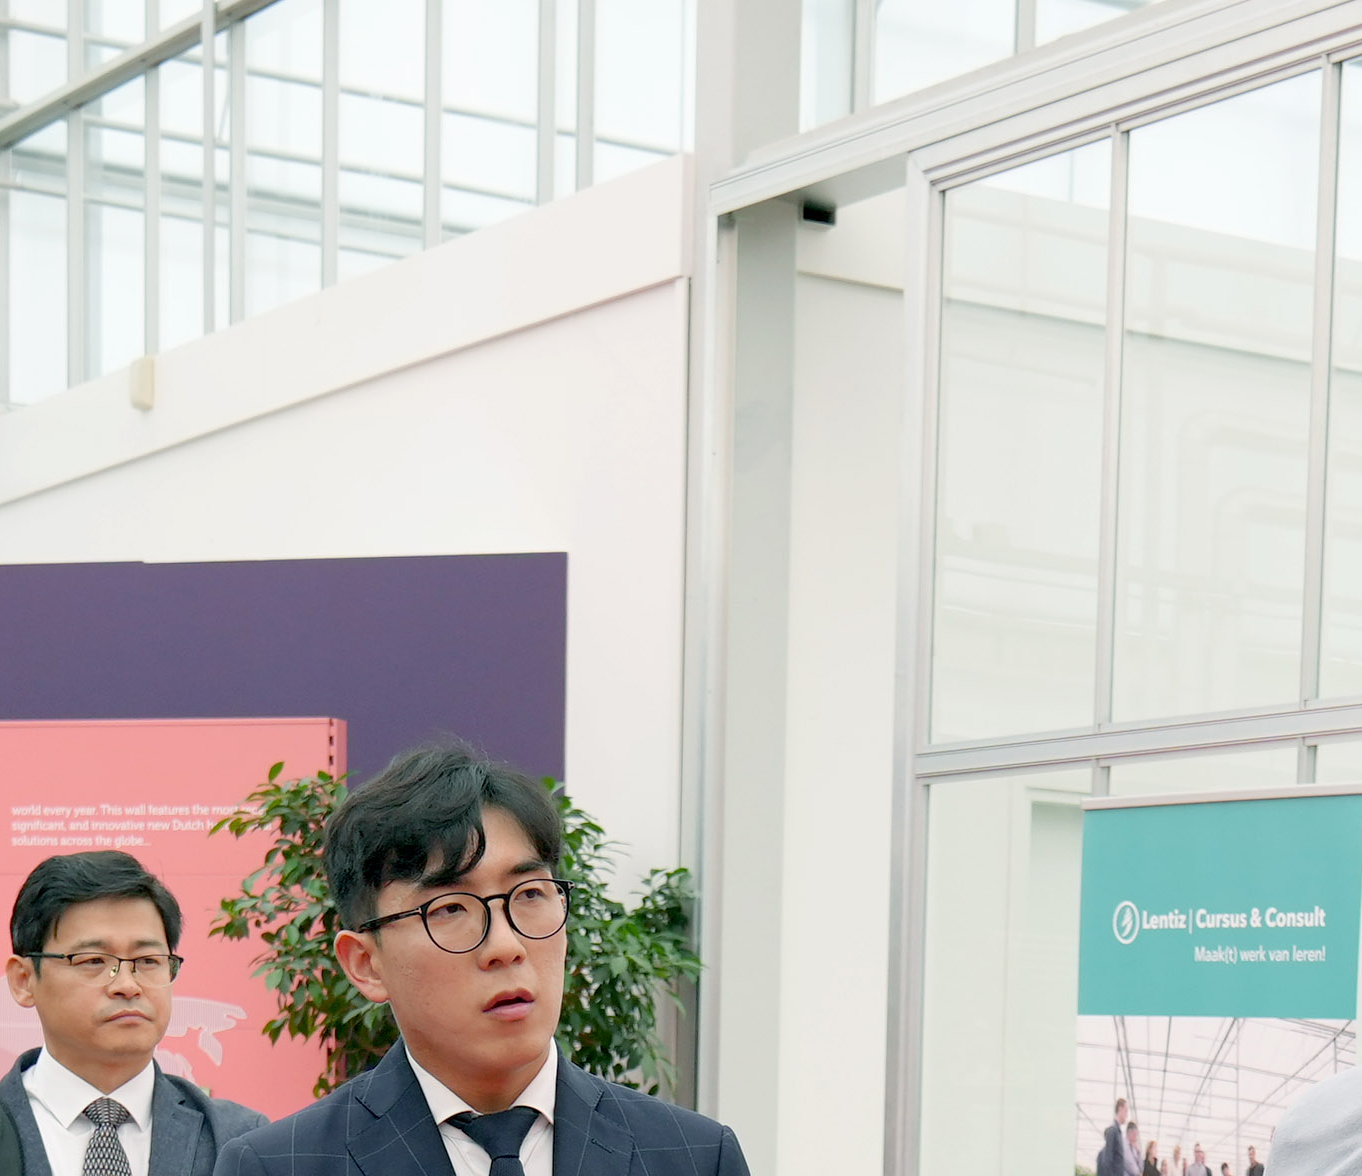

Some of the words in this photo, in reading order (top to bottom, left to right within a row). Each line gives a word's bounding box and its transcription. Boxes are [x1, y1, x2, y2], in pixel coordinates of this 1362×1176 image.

[12, 804, 41, 816] world
[43, 805, 71, 818] every
[74, 805, 98, 818] year.
[101, 803, 122, 816] This
[125, 804, 146, 816] wall
[149, 804, 190, 816] features
[193, 804, 210, 816] the
[213, 804, 239, 816] most
[12, 820, 66, 833] significant,
[69, 820, 89, 831] and
[92, 820, 145, 831] innovative
[147, 821, 169, 831] new
[173, 819, 204, 831] Dutch
[12, 836, 58, 847] solutions
[60, 837, 93, 847] across
[96, 835, 112, 847] the
[1142, 909, 1187, 930] Lentiz
[1195, 908, 1247, 929] Cursus
[1250, 908, 1262, 929] &
[1264, 905, 1327, 928] Consult
[1194, 945, 1238, 964] Maak(t)
[1240, 945, 1266, 962] werk
[1268, 949, 1290, 962] van
[1293, 944, 1327, 962] leren!
